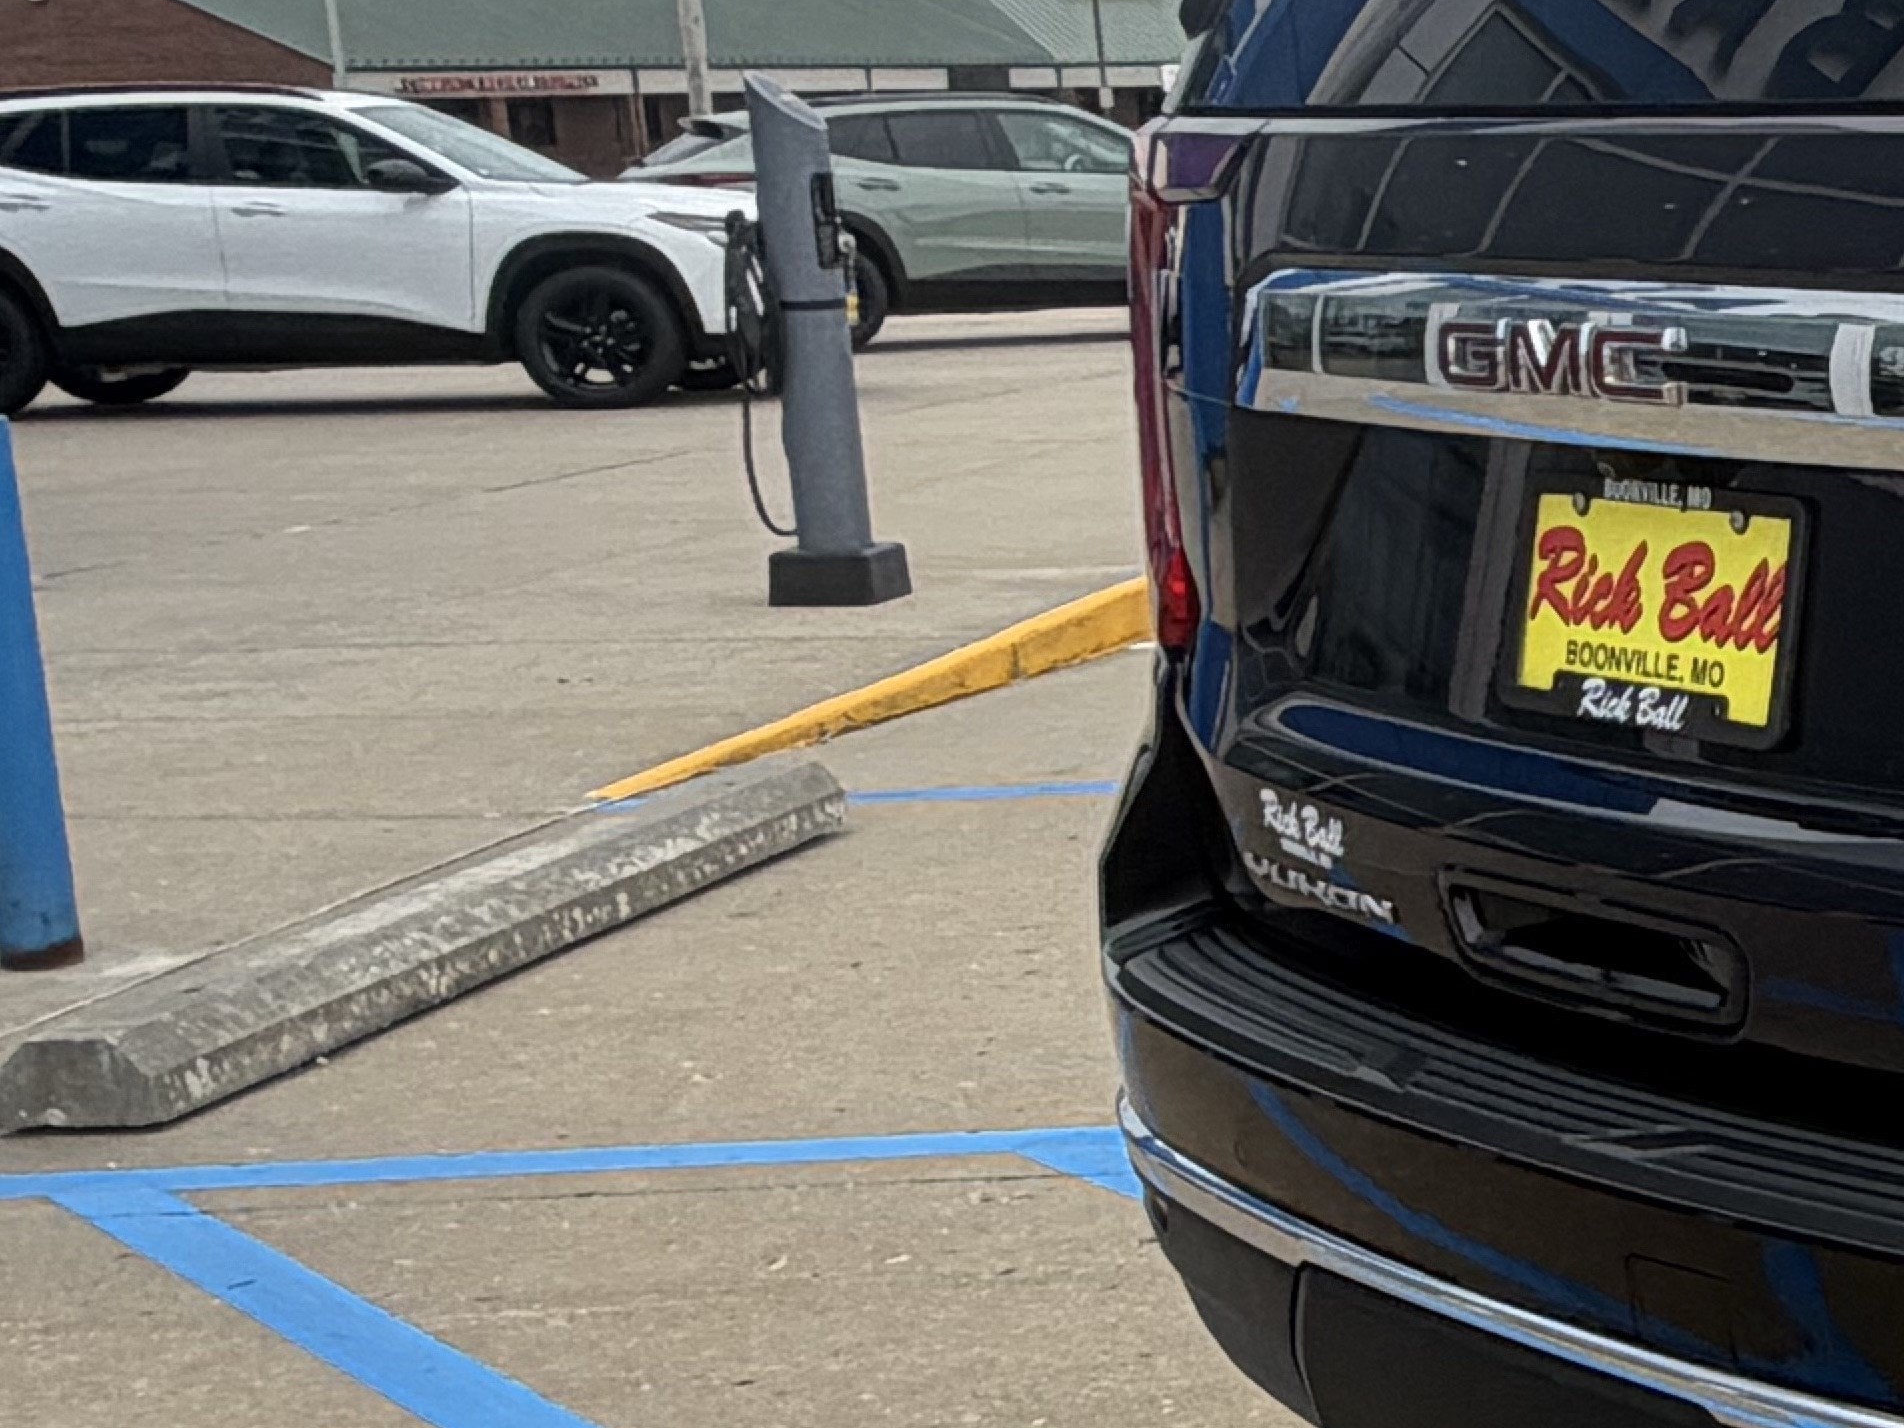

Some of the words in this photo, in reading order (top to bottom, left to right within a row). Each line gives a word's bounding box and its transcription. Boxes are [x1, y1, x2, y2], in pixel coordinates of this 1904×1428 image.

[1437, 317, 1688, 406] GMC
[1531, 525, 1648, 634] Rick
[1659, 540, 1787, 654] Ball
[1577, 678, 1634, 723] Rick
[1635, 688, 1689, 730] Ball
[1691, 657, 1724, 687] MO
[1243, 852, 1394, 922] YUKON
